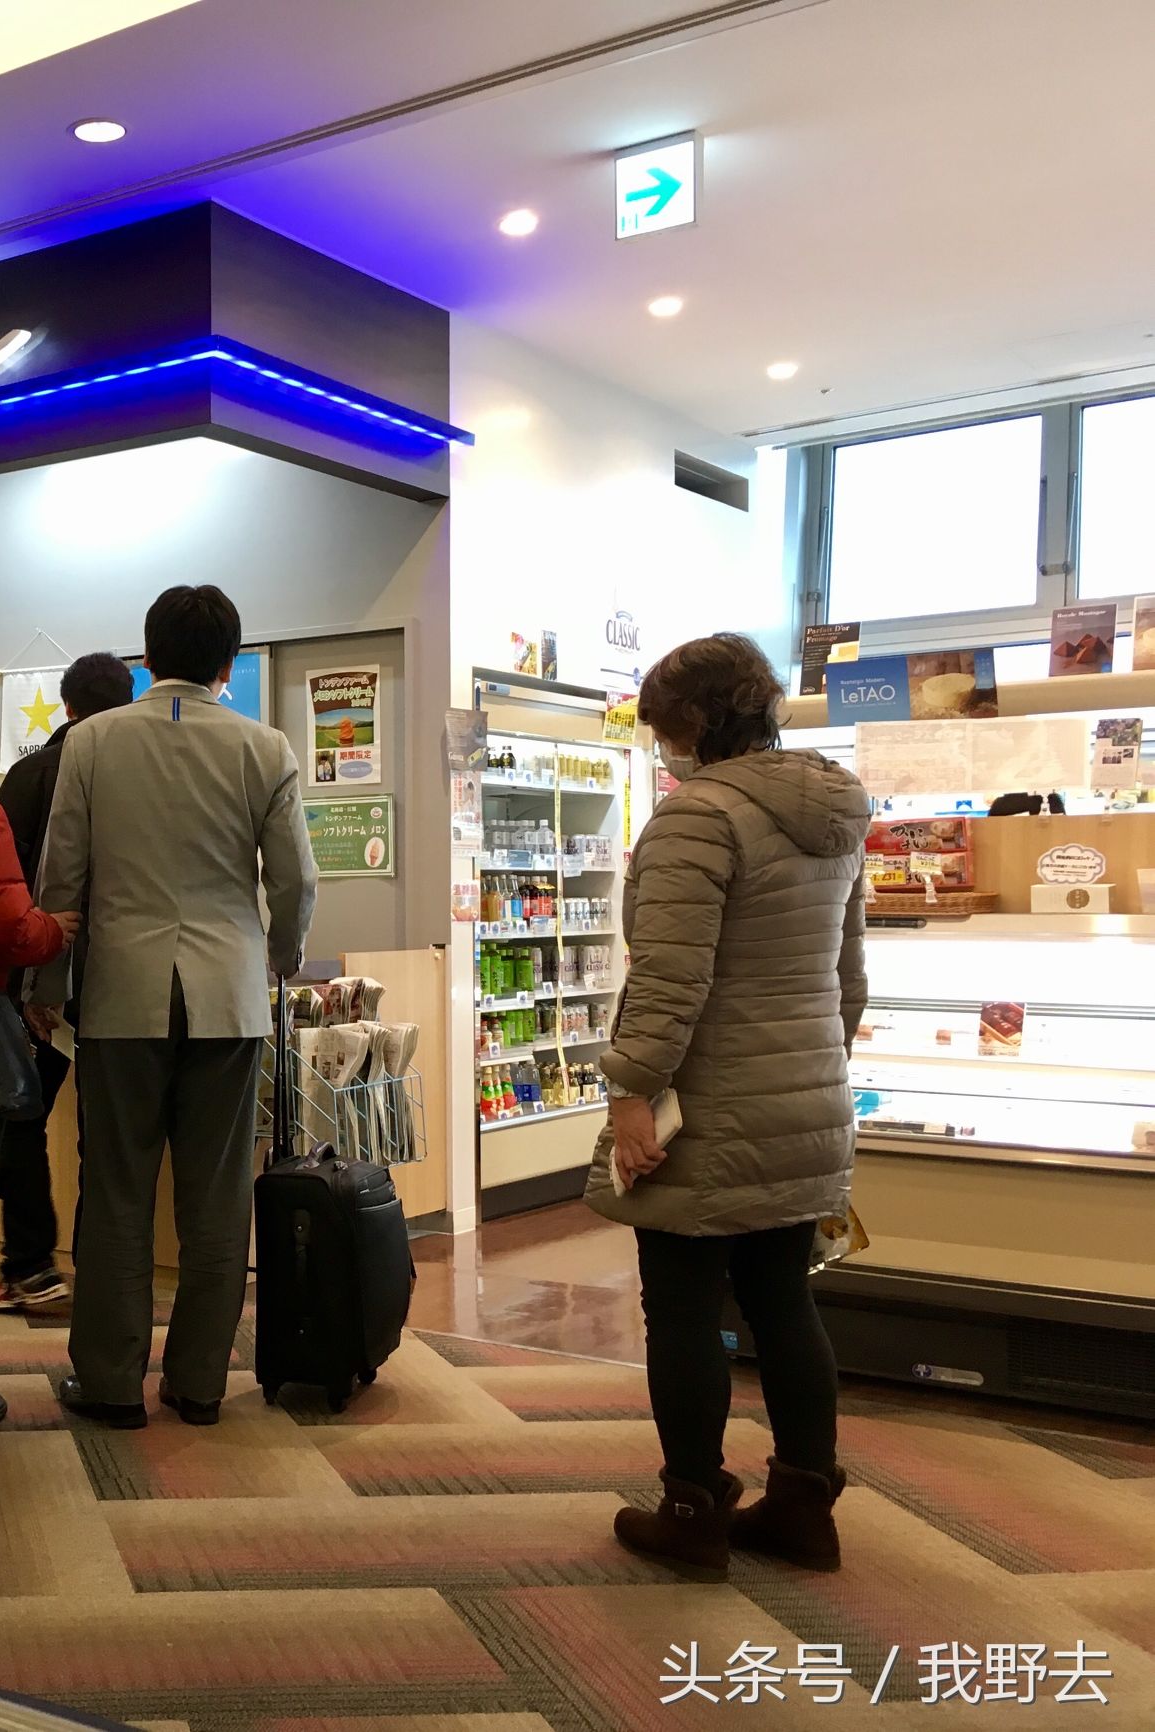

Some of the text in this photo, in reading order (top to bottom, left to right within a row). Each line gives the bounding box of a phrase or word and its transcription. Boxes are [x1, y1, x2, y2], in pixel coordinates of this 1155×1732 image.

[606, 619, 640, 651] CLASSIC
[840, 684, 895, 704] LeTAO
[18, 744, 46, 756] SAPP
[323, 825, 366, 837] ソフトクリーム
[369, 824, 387, 835] メロン
